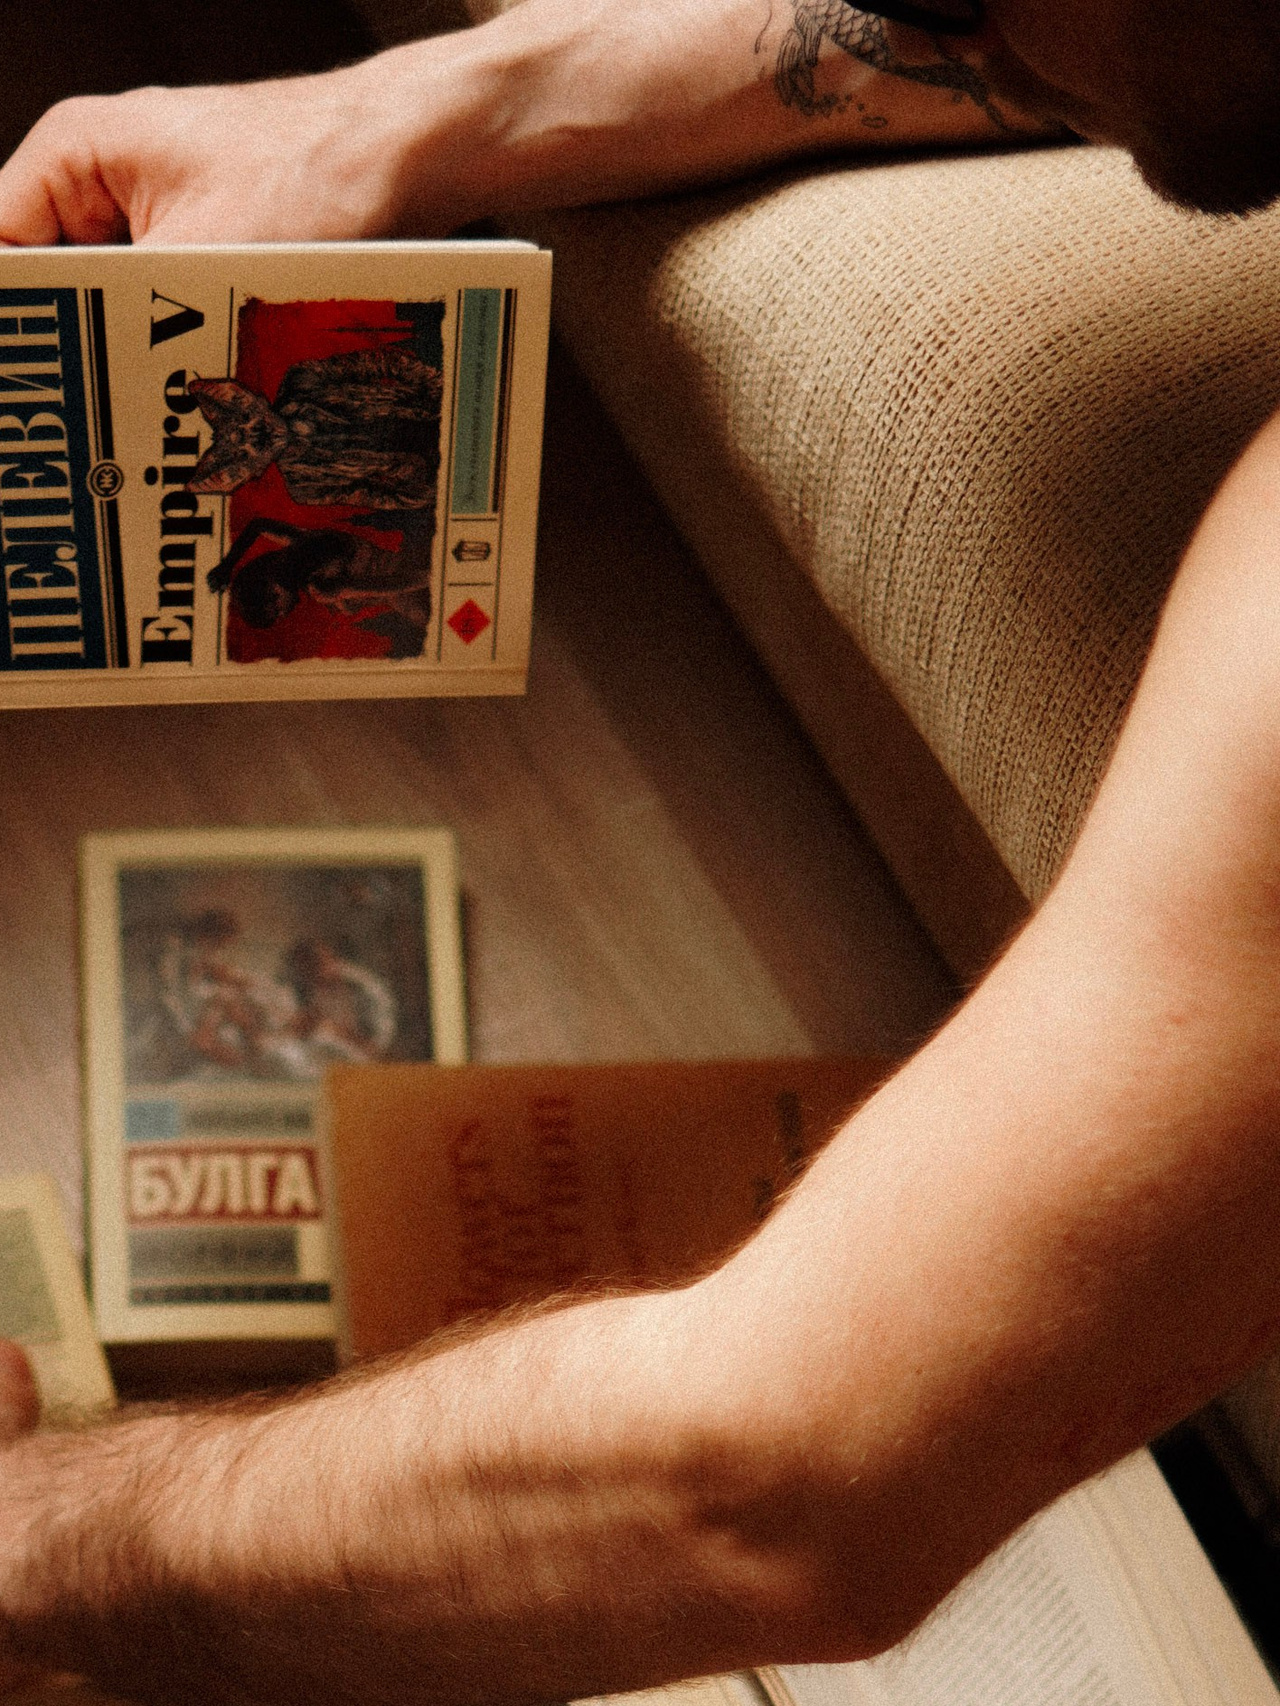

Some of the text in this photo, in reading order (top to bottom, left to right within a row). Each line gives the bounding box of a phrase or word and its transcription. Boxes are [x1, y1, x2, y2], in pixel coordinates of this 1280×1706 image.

[141, 288, 214, 668] Empire V
[129, 1152, 318, 1217] БУЛГА
